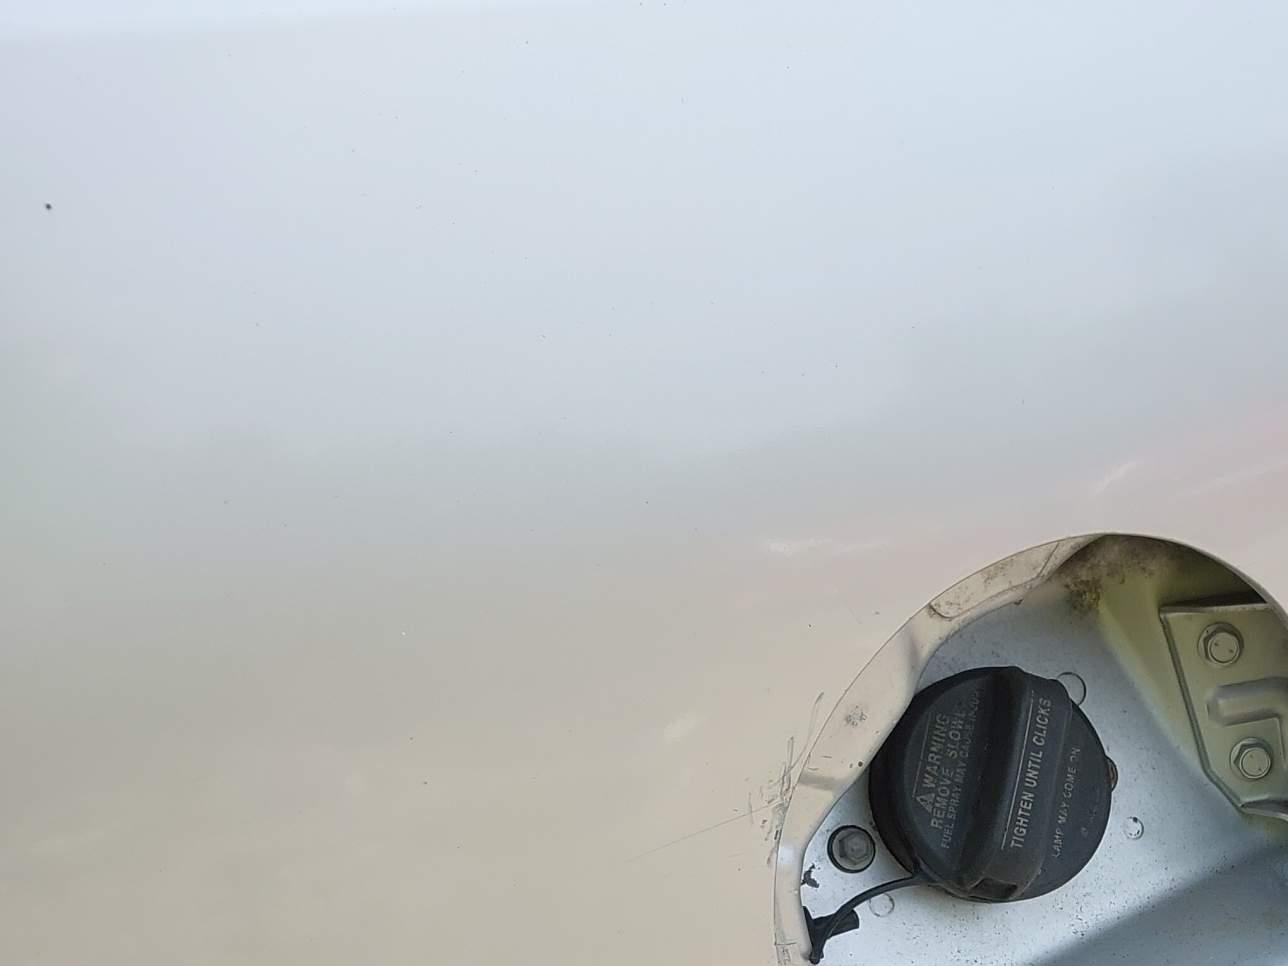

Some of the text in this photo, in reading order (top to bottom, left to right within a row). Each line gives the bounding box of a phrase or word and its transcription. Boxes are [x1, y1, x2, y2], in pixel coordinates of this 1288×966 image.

[922, 712, 951, 788] WARNING
[930, 703, 968, 829] REMOVE SLOWL
[953, 759, 968, 785] MAY
[1009, 696, 1053, 849] TIGHTEN UNTIL CLICKS
[1061, 766, 1078, 798] COME
[946, 785, 962, 820] SPRAY
[1057, 802, 1070, 826] MAY
[940, 823, 954, 849] FUEL
[1051, 828, 1065, 859] LAMP
